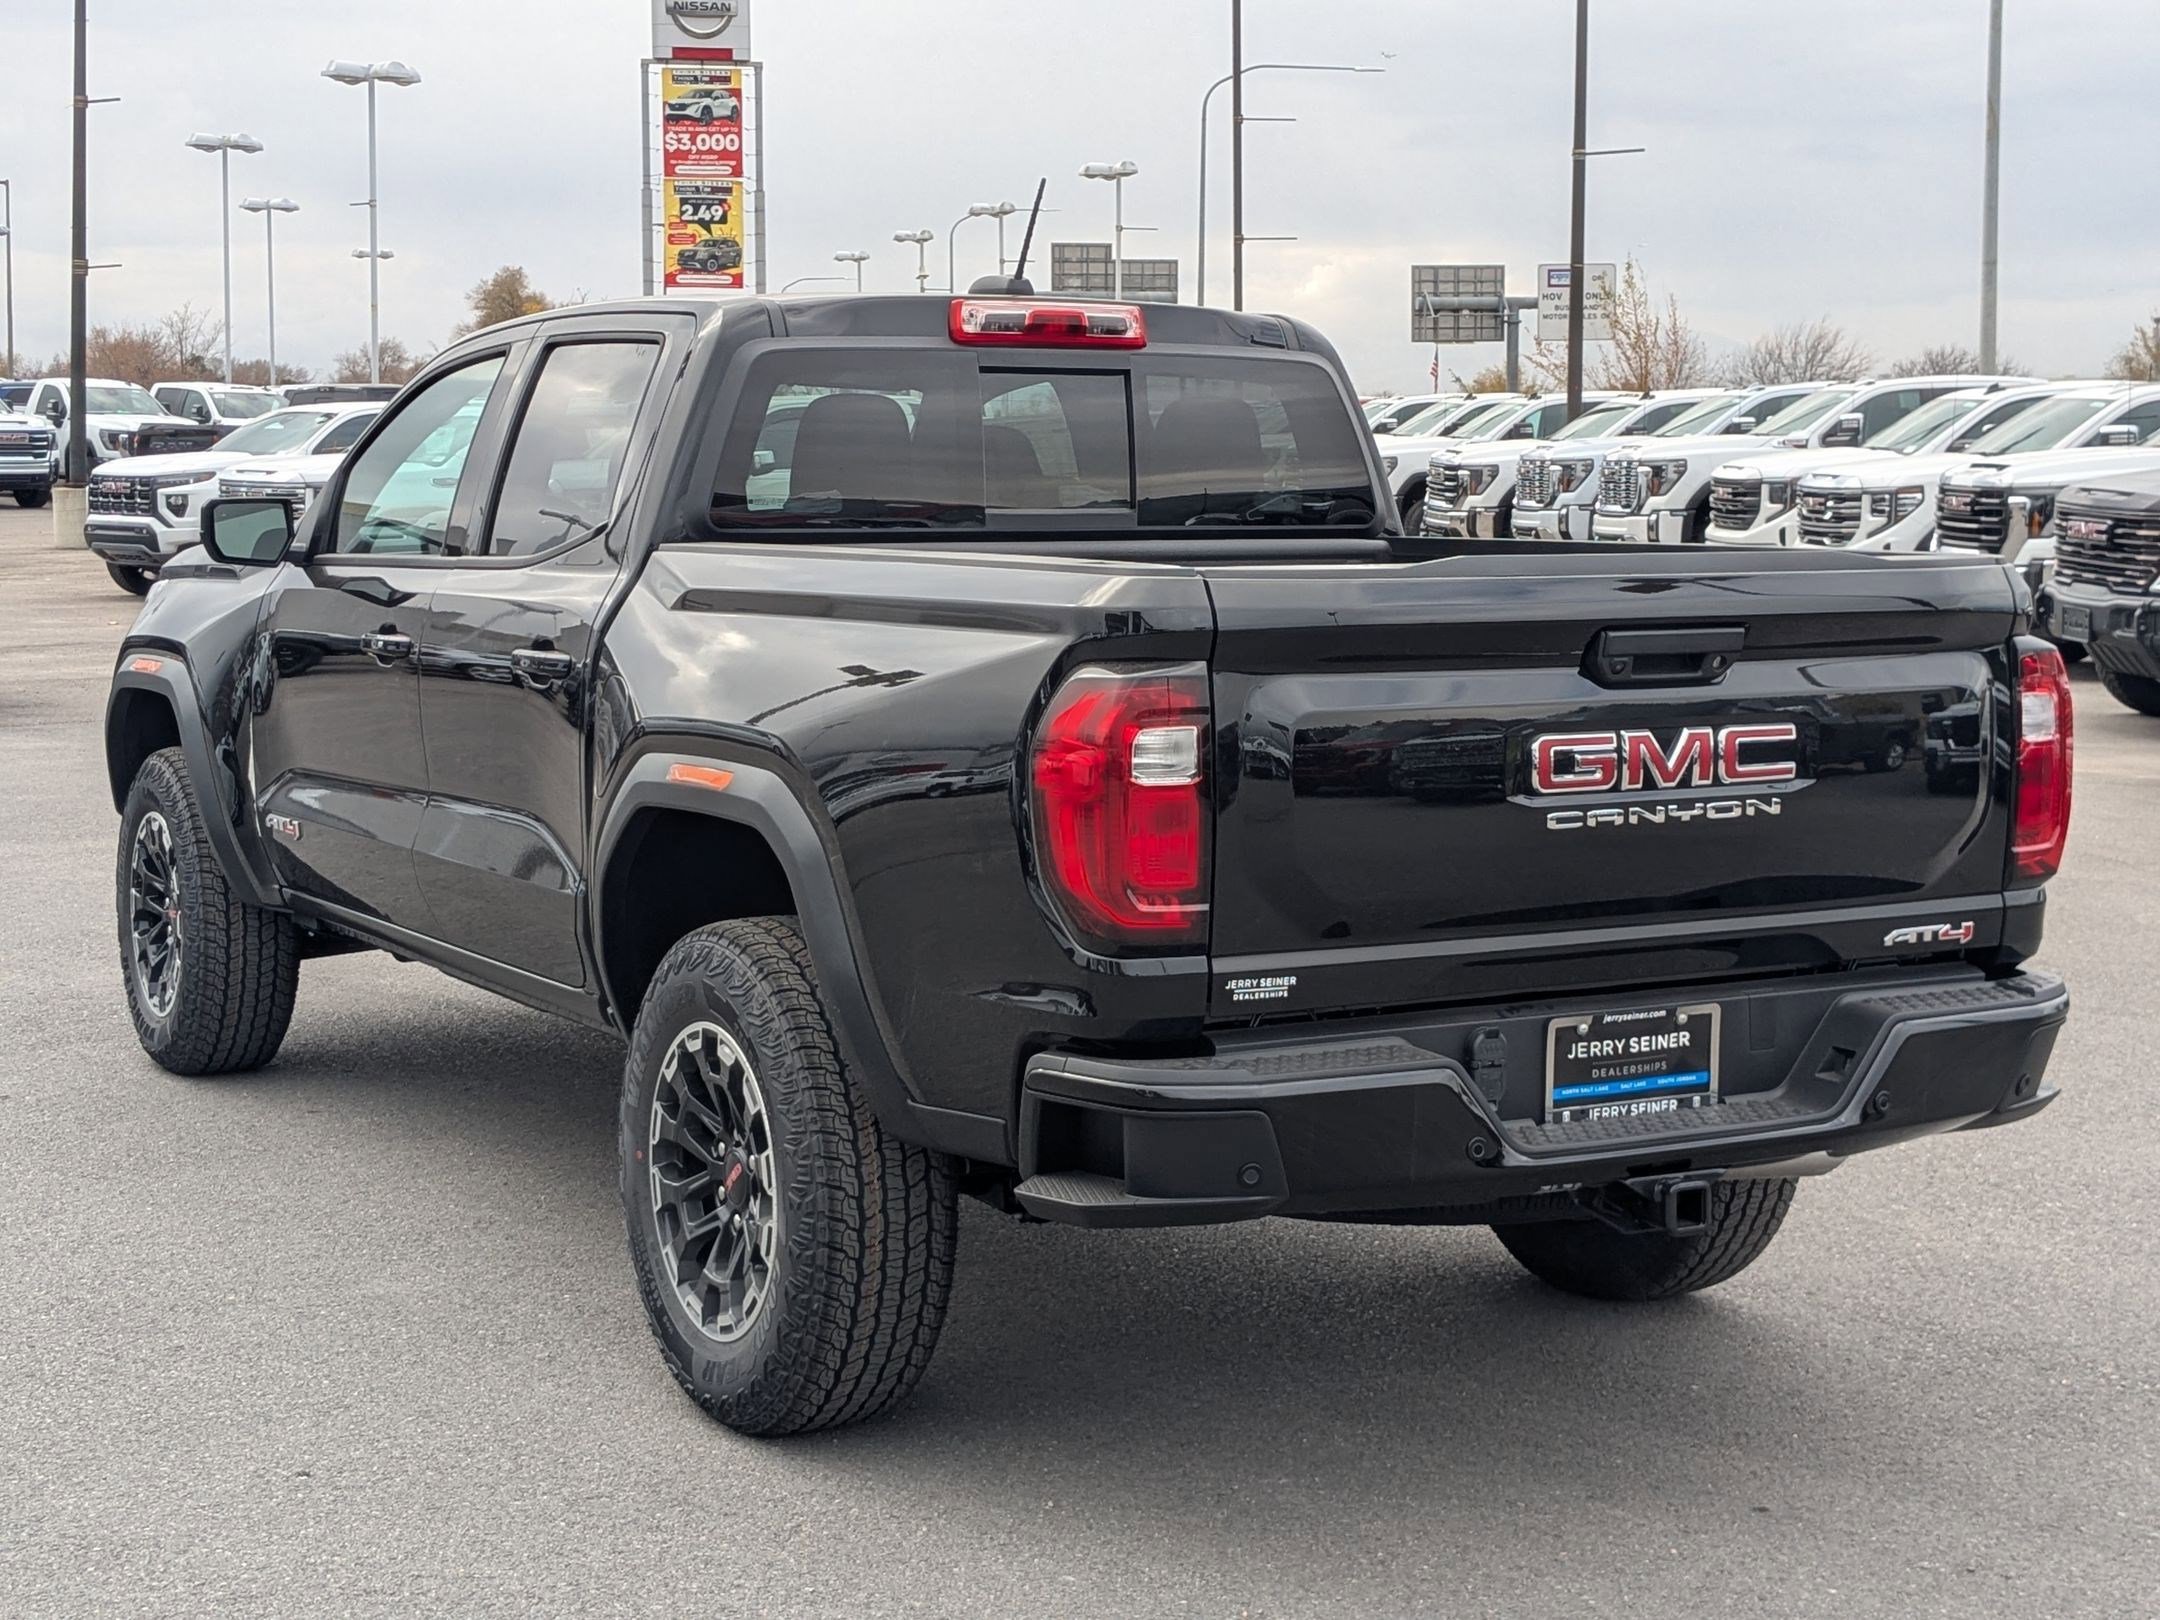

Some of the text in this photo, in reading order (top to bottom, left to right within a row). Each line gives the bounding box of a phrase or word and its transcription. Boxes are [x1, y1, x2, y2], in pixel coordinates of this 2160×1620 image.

[673, 1, 731, 12] NISSAN
[665, 131, 740, 154] $3,000
[1542, 292, 1563, 301] HOV
[1531, 722, 1797, 794] GMC
[1546, 797, 1782, 830] CANYON
[1884, 921, 1975, 946] AT4
[1225, 976, 1297, 989] JERRY SEINER
[1233, 990, 1288, 1001] DEALERSHIPS
[1567, 1031, 1691, 1059] JERRY SEINER
[1591, 1060, 1668, 1078] DEALERSHIPS
[1634, 1080, 1646, 1088] LAKE
[1676, 1075, 1696, 1083] JORDAN
[1580, 1086, 1594, 1094] SALT
[1587, 1098, 1678, 1121] JERRY SEINER
